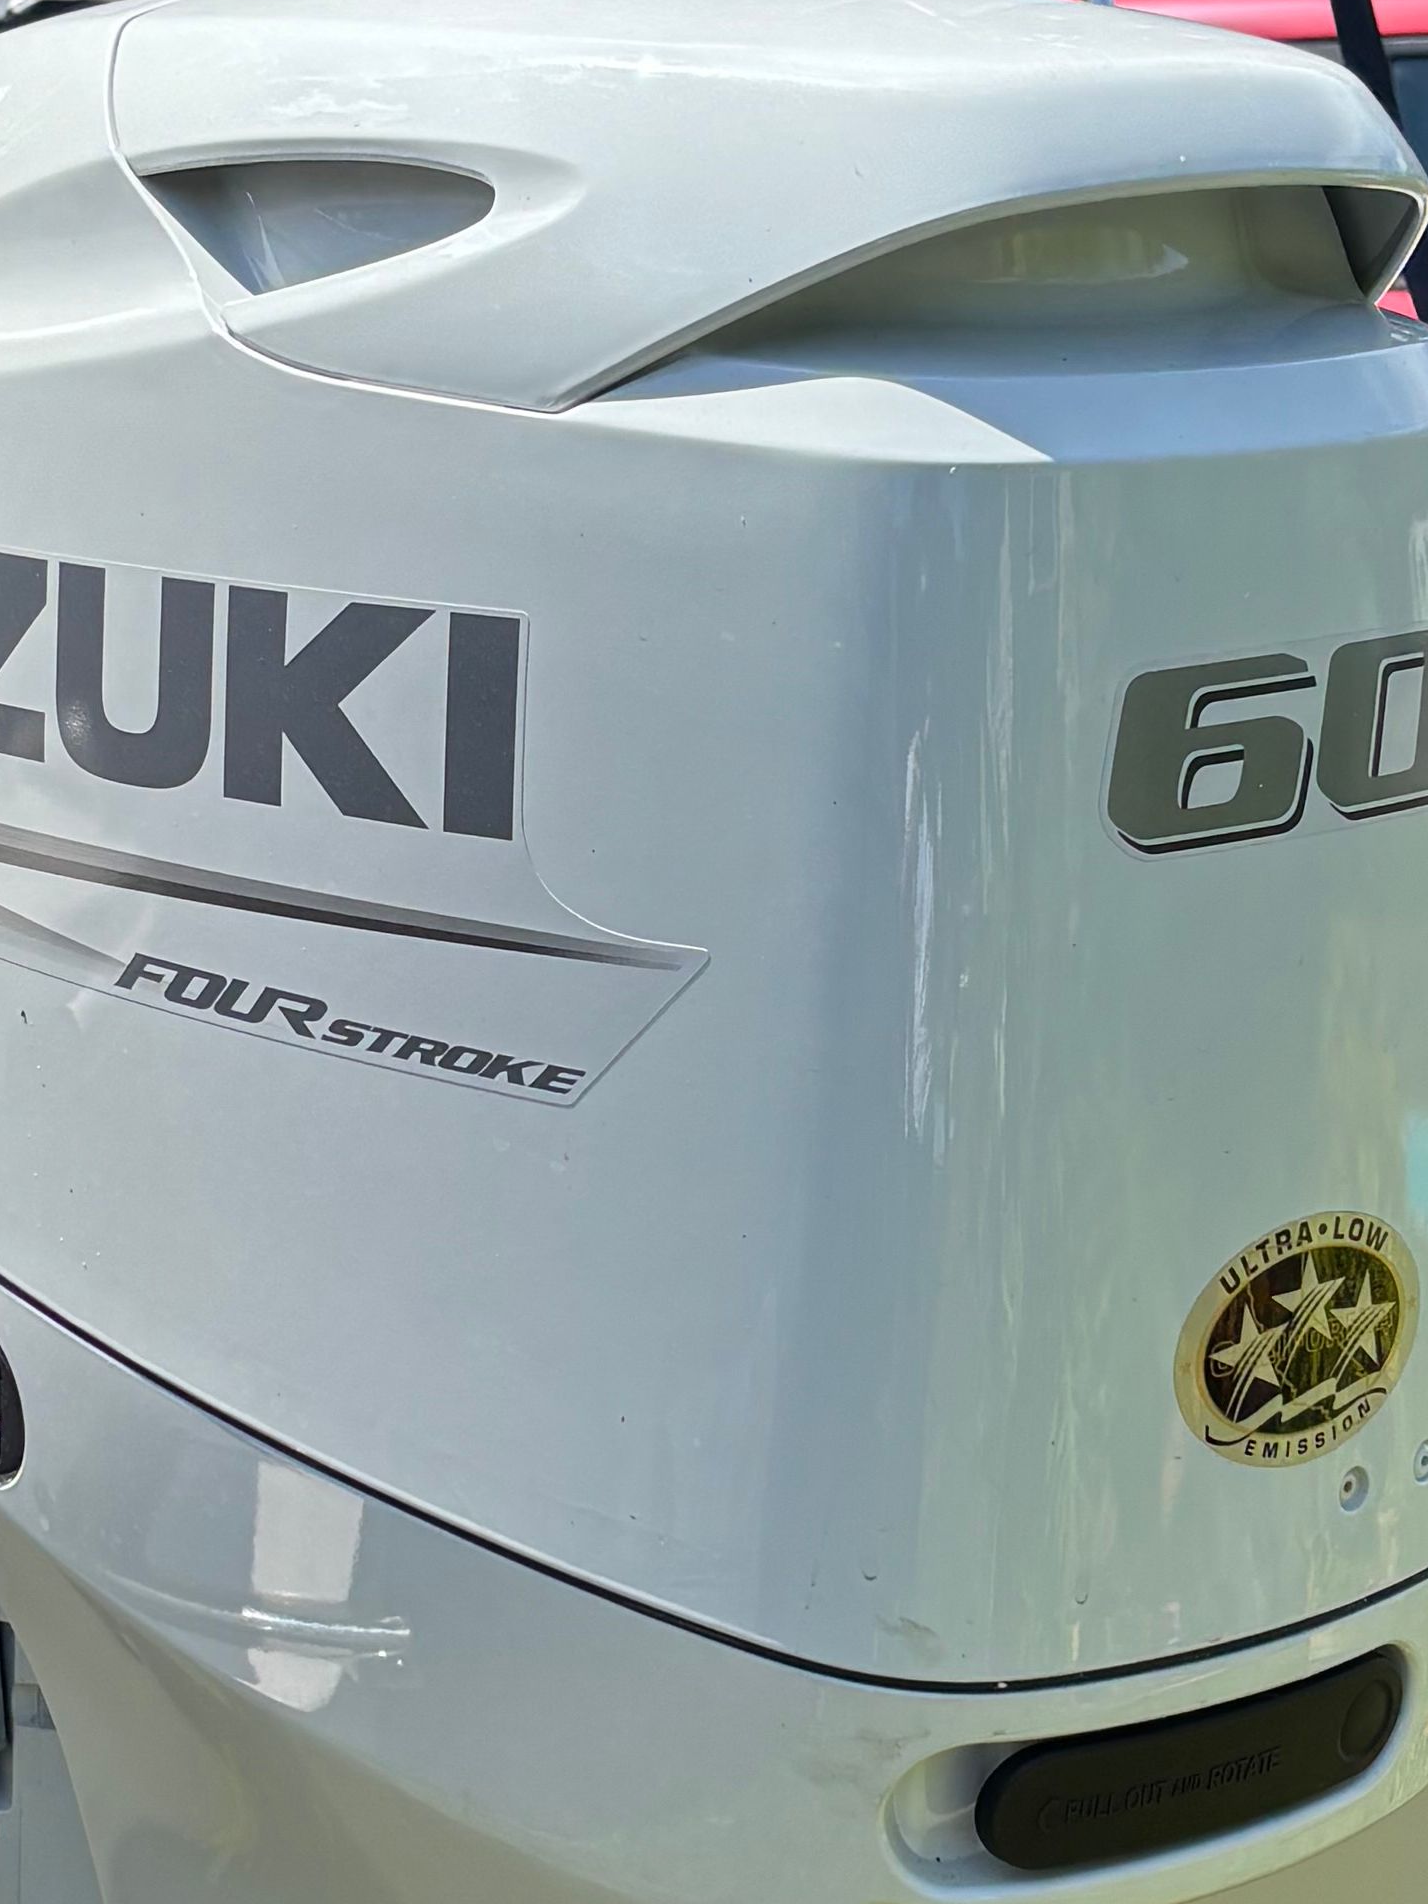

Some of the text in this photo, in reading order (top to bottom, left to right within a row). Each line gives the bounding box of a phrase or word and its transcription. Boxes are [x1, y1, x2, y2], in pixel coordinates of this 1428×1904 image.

[114, 952, 586, 1095] FOUR STROKE
[1220, 1215, 1389, 1295] ULTRA LOW
[1244, 1398, 1372, 1459] EMISSION
[1063, 1746, 1282, 1822] PULL OUT AND ROTATE
